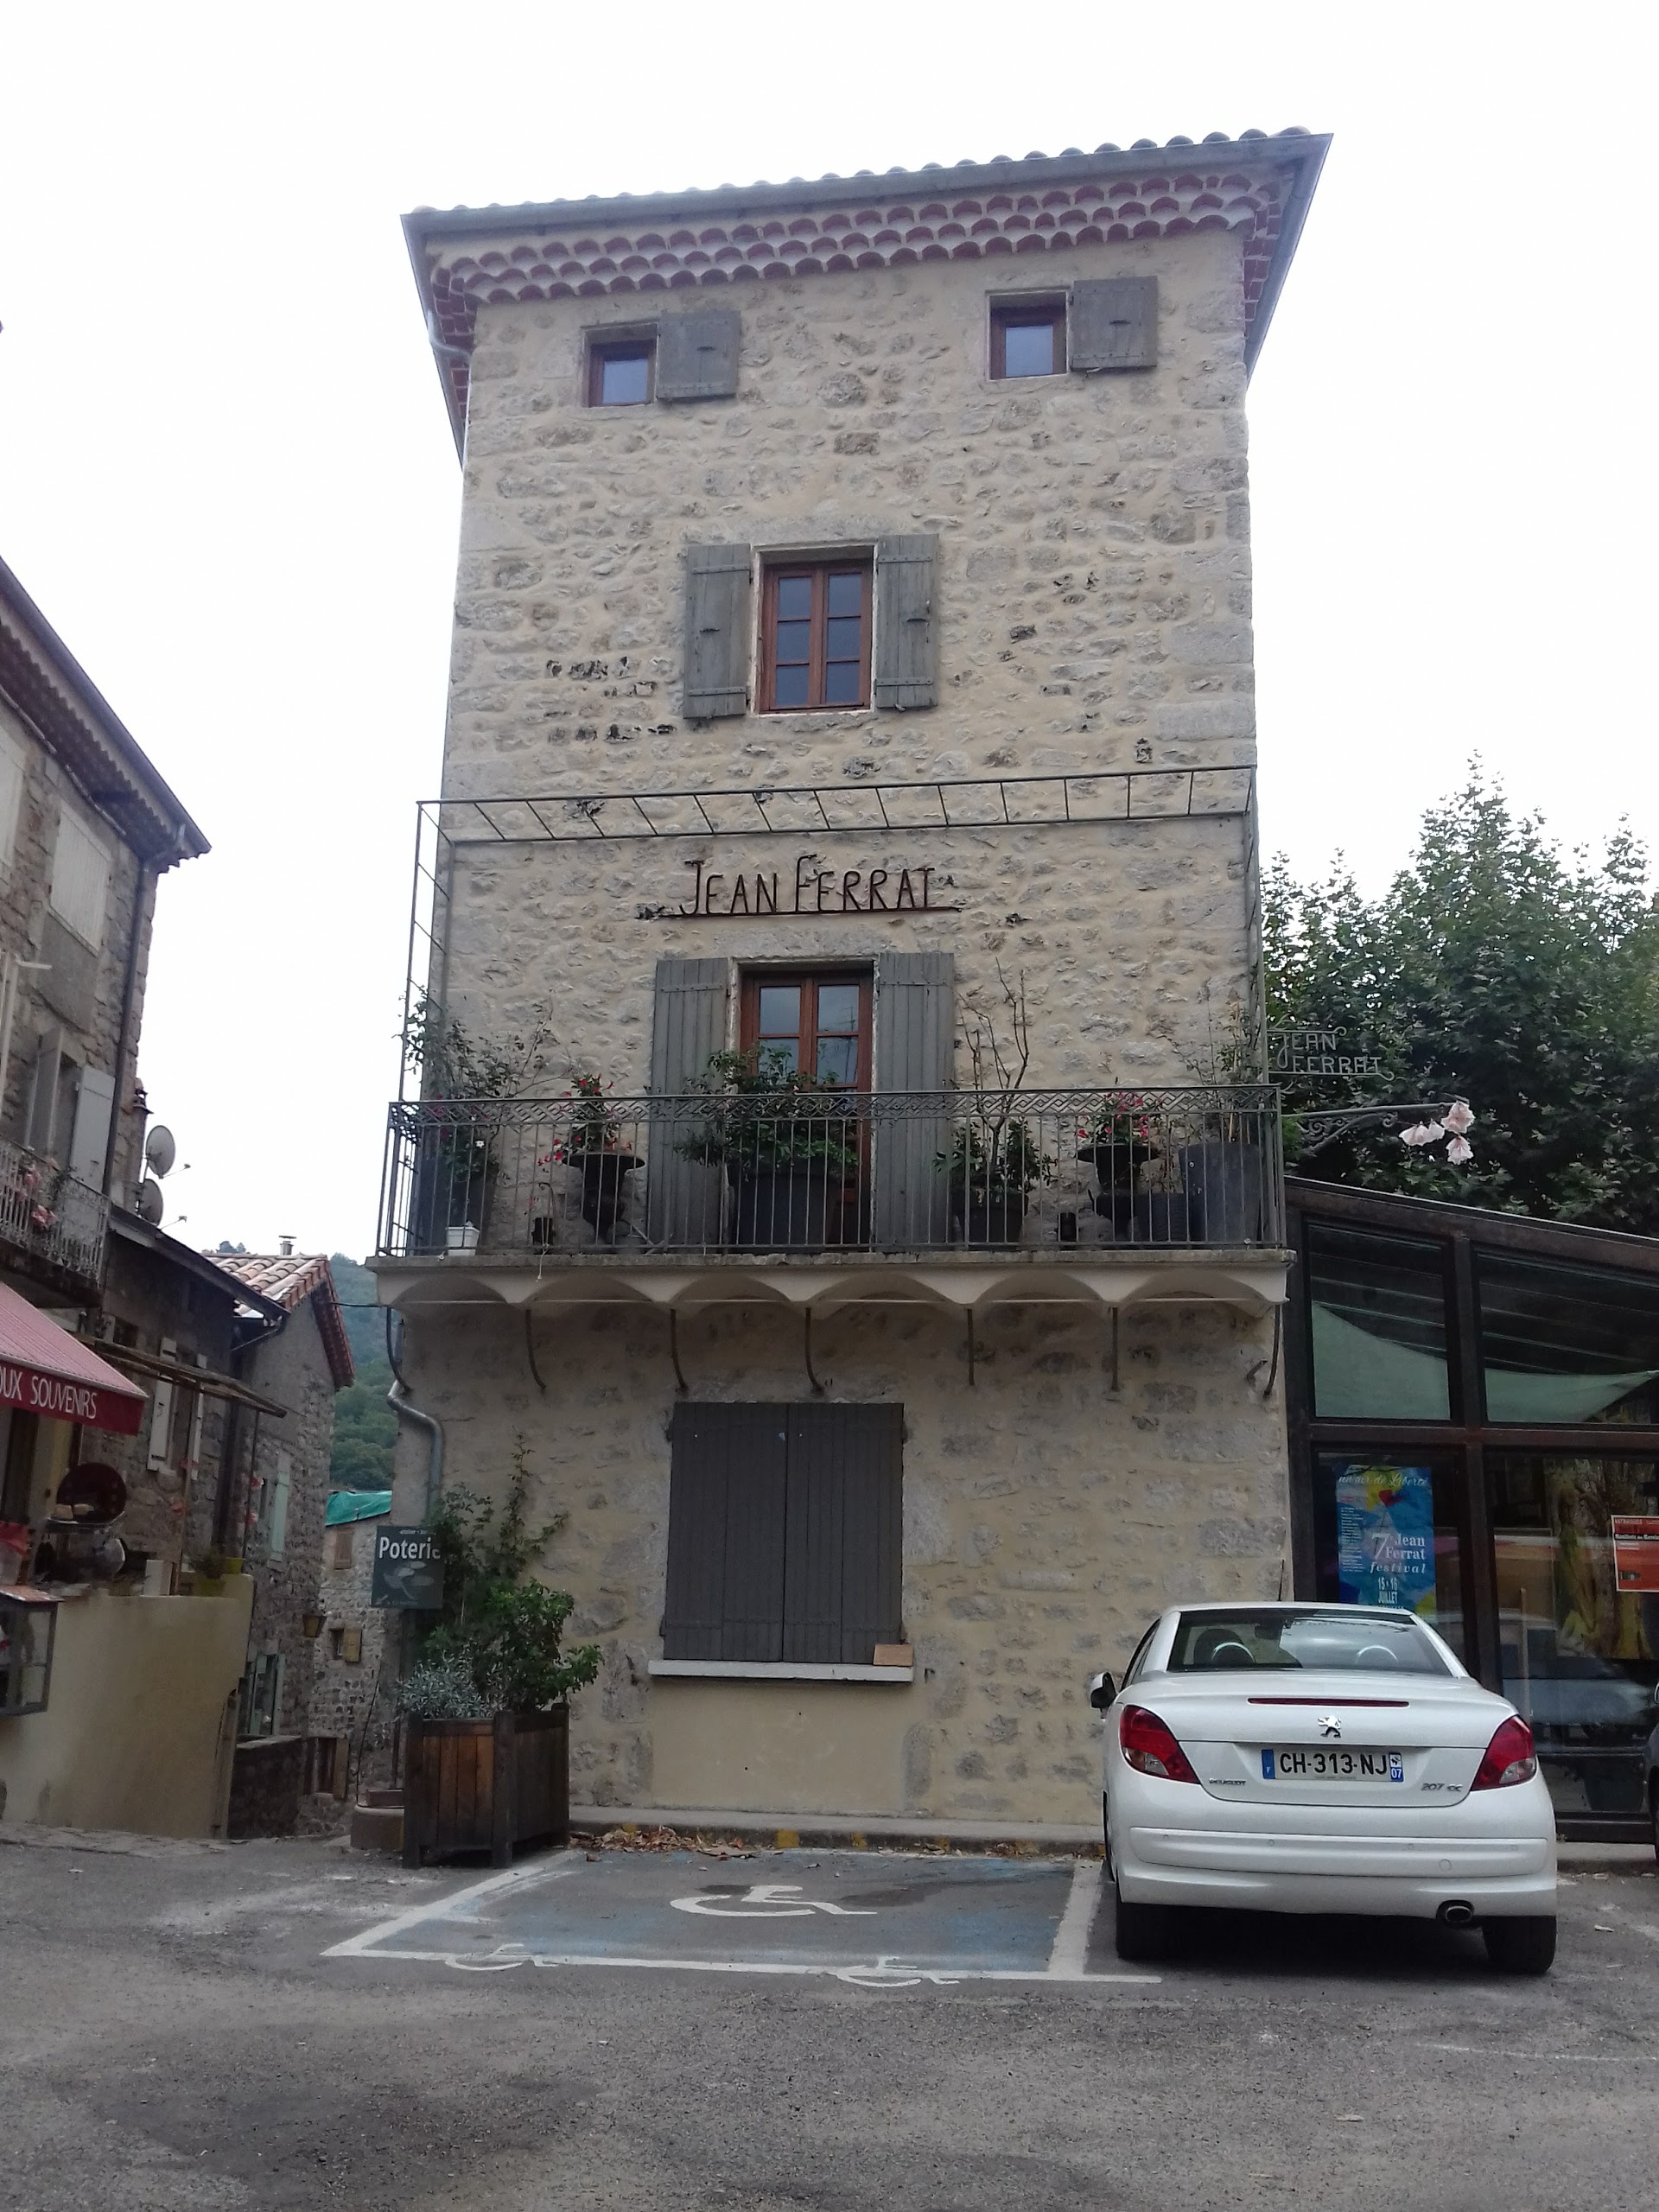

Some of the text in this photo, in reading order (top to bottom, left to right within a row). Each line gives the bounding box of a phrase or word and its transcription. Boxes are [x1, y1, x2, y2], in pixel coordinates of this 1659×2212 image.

[678, 854, 936, 915] JEAN FERRAT
[1274, 1033, 1337, 1068] JEAN
[1293, 1056, 1382, 1074] FERRAT
[0, 1365, 98, 1420] UX SOUVENIRS
[1395, 1533, 1426, 1547] Jean
[1386, 1546, 1427, 1560] Ferrat
[1370, 1561, 1426, 1574] festival
[1280, 1752, 1387, 1776] CH-313-NJ
[1390, 1768, 1402, 1779] 07
[1421, 1783, 1445, 1791] 207
